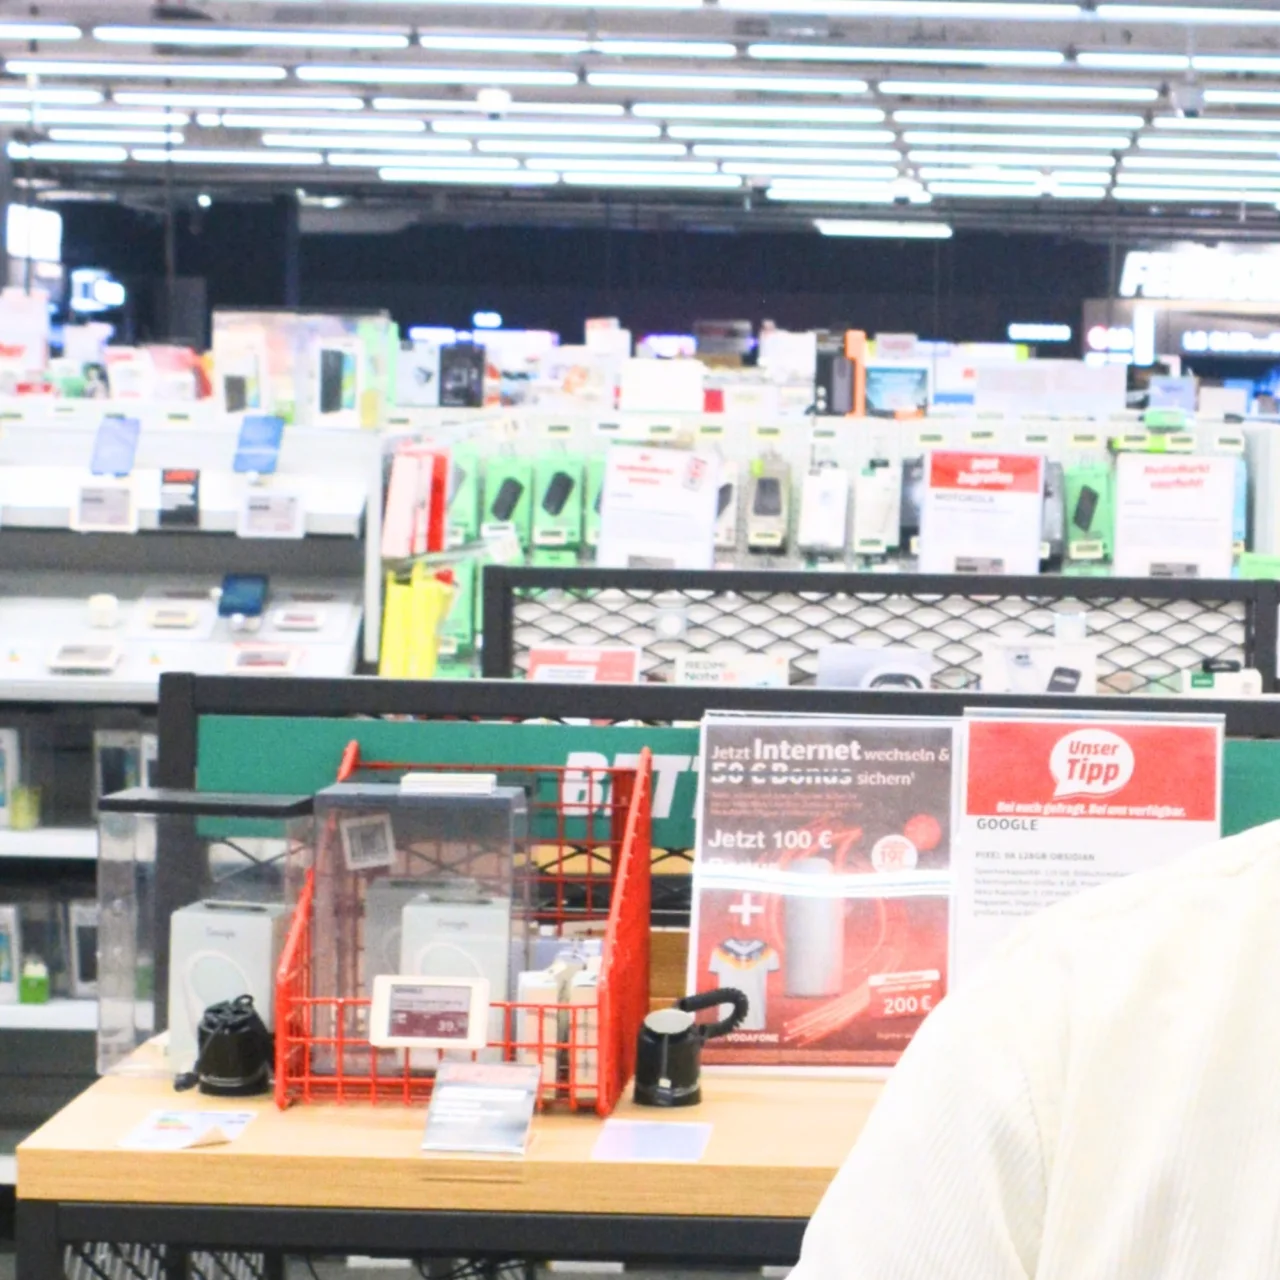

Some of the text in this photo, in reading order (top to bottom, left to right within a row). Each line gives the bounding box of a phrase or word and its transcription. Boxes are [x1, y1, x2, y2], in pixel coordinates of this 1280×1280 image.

[710, 738, 950, 762] Jetzt Internet wechseln &
[1068, 740, 1120, 757] Unser
[771, 762, 853, 785] Bonus
[1066, 758, 1121, 785] Tipp
[976, 818, 1039, 831] GOOGLE
[707, 829, 833, 849] Jetzt 100 €
[884, 997, 918, 1015] 200
[726, 1033, 779, 1043] VODAFONE
